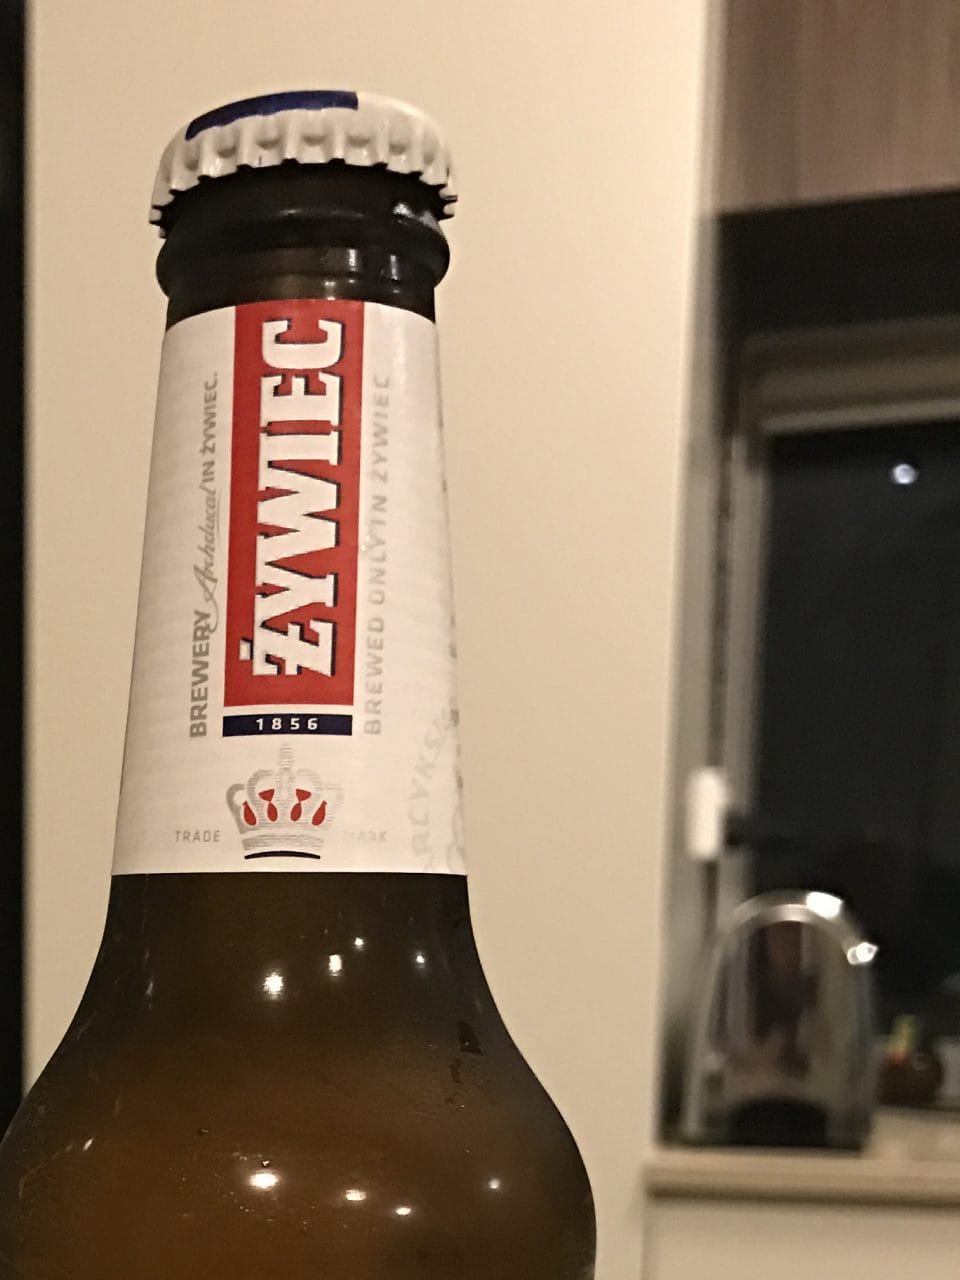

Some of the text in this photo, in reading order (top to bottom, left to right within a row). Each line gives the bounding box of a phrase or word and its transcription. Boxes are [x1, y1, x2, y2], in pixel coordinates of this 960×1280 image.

[201, 460, 216, 483] IN
[239, 319, 344, 678] ŻYWIEC
[370, 495, 387, 525] IN
[193, 483, 221, 630] Archducal
[367, 531, 387, 605] ONLY
[190, 610, 211, 738] BREWERY
[364, 616, 385, 735] BREWED
[255, 717, 319, 731] 1856
[175, 830, 221, 842] TRADE
